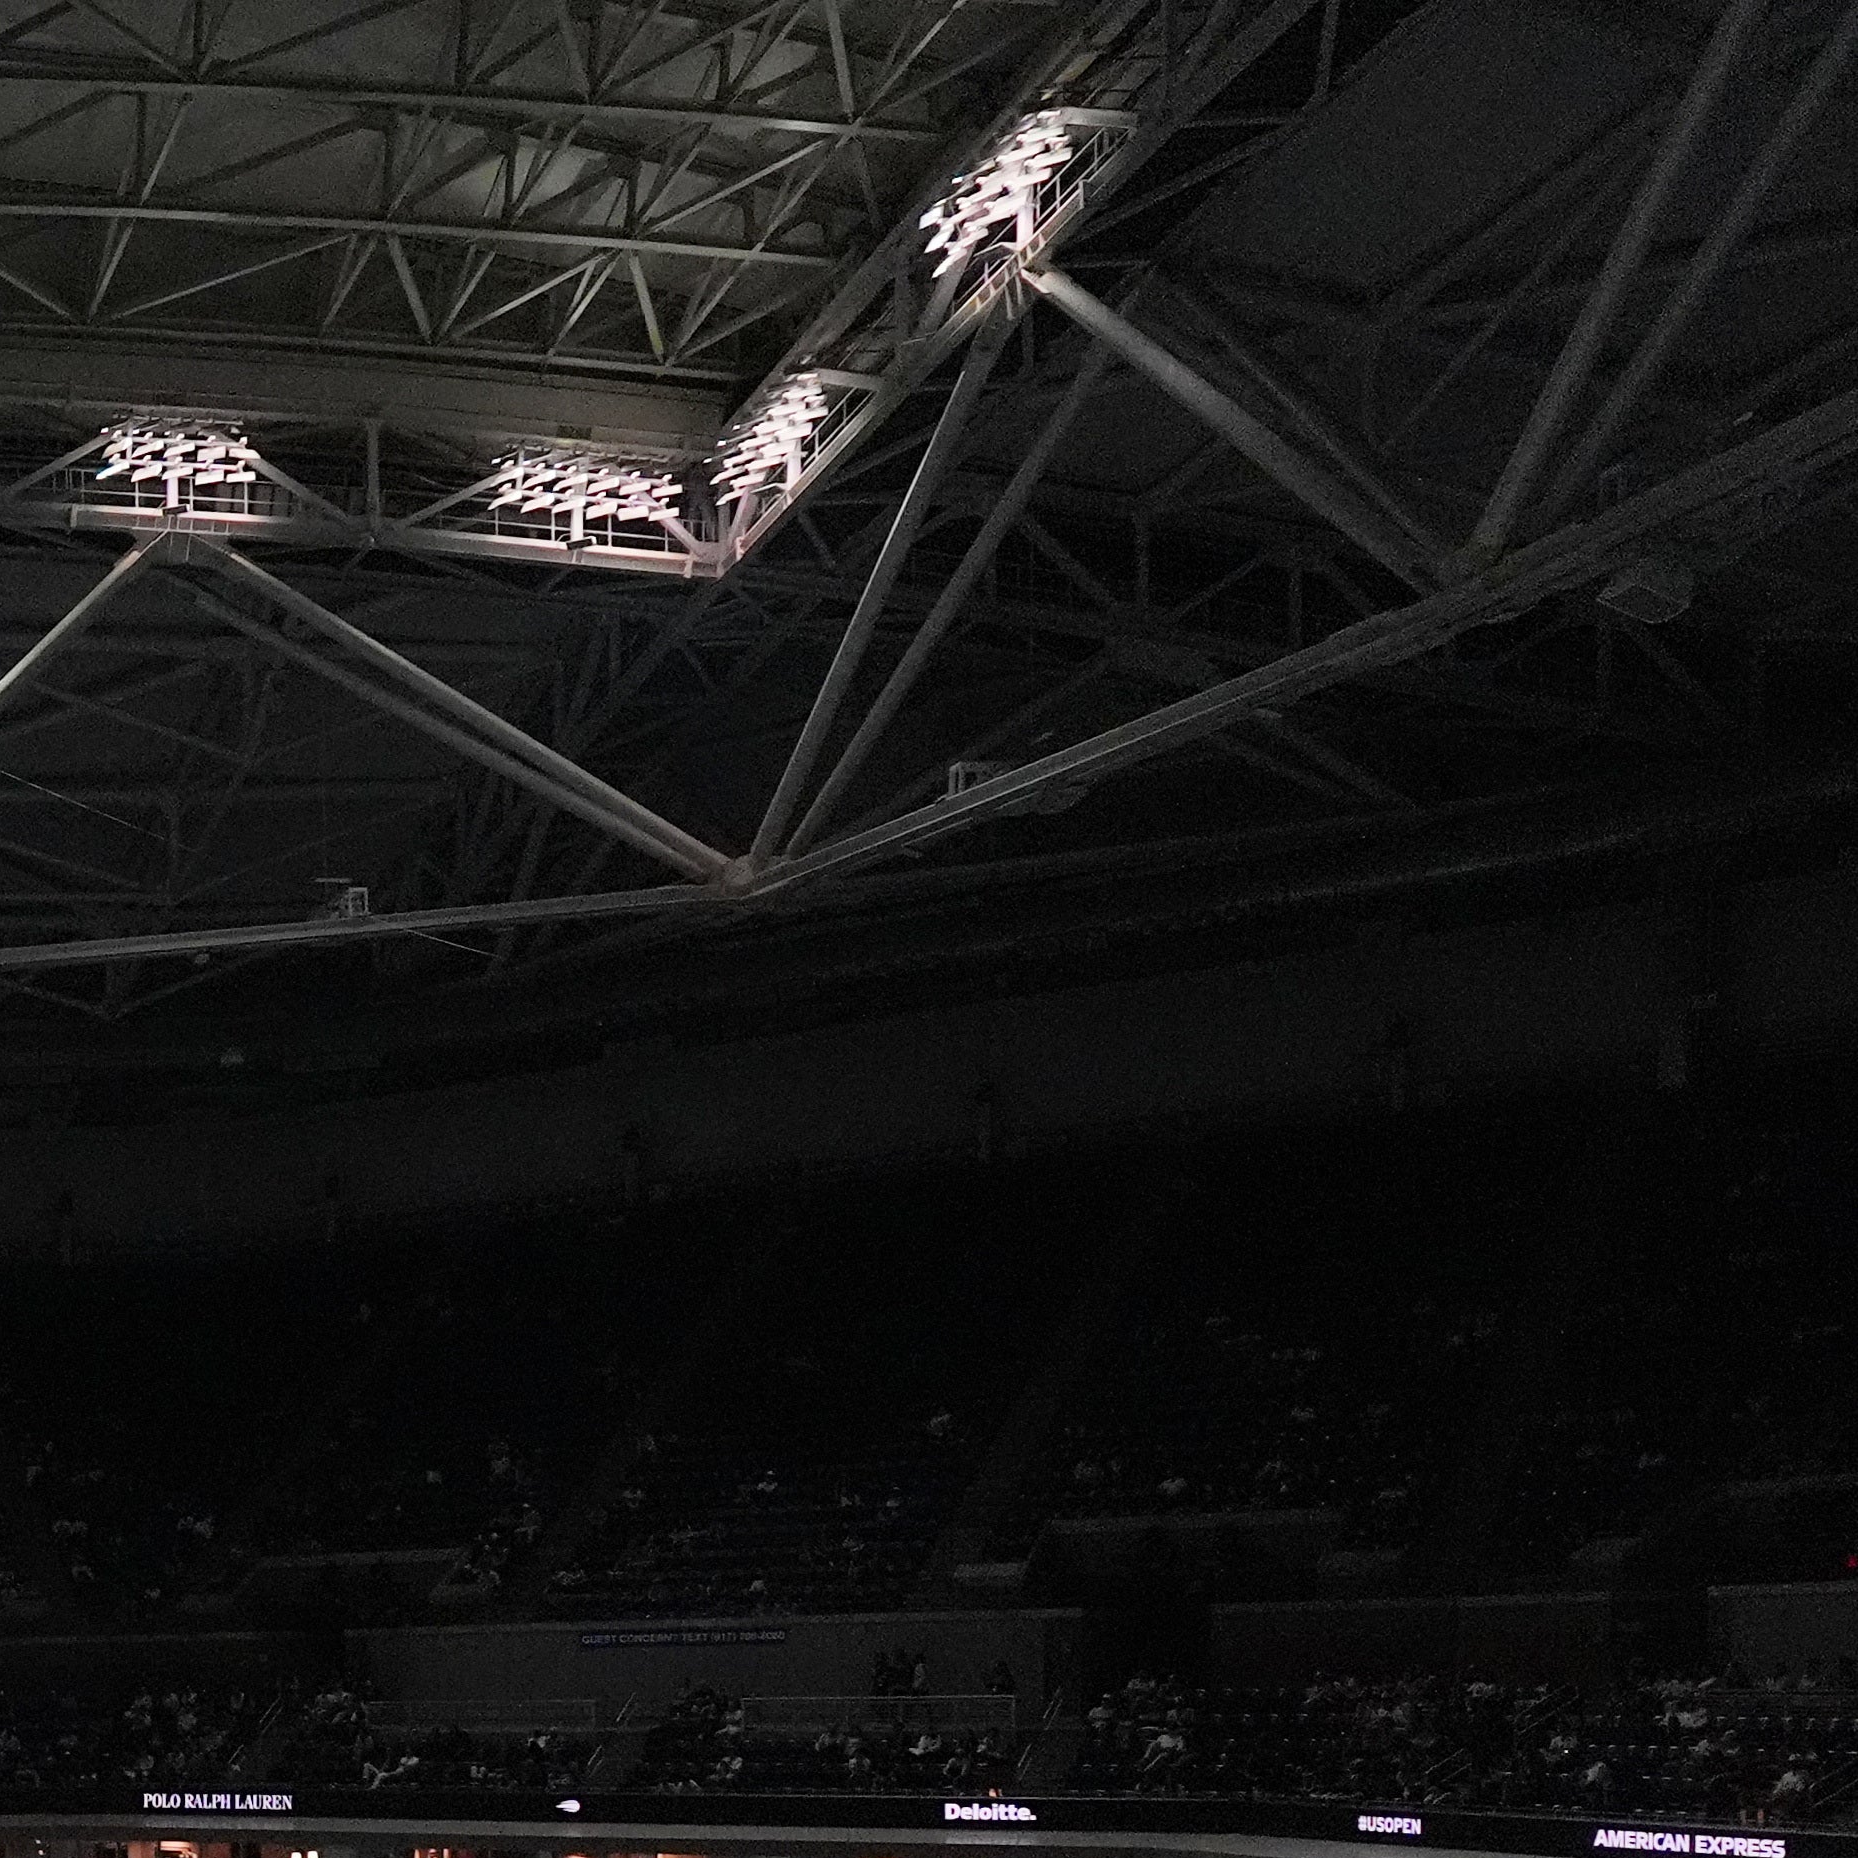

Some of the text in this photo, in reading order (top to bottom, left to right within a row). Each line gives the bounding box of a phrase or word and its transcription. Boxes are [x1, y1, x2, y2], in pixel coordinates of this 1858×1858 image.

[143, 1793, 293, 1810] POLO RALPH LAUREN
[944, 1803, 1037, 1821] Deloitte.
[1357, 1815, 1422, 1835] #USOPEN
[1593, 1828, 1786, 1858] AMERICAN EXPRESS
